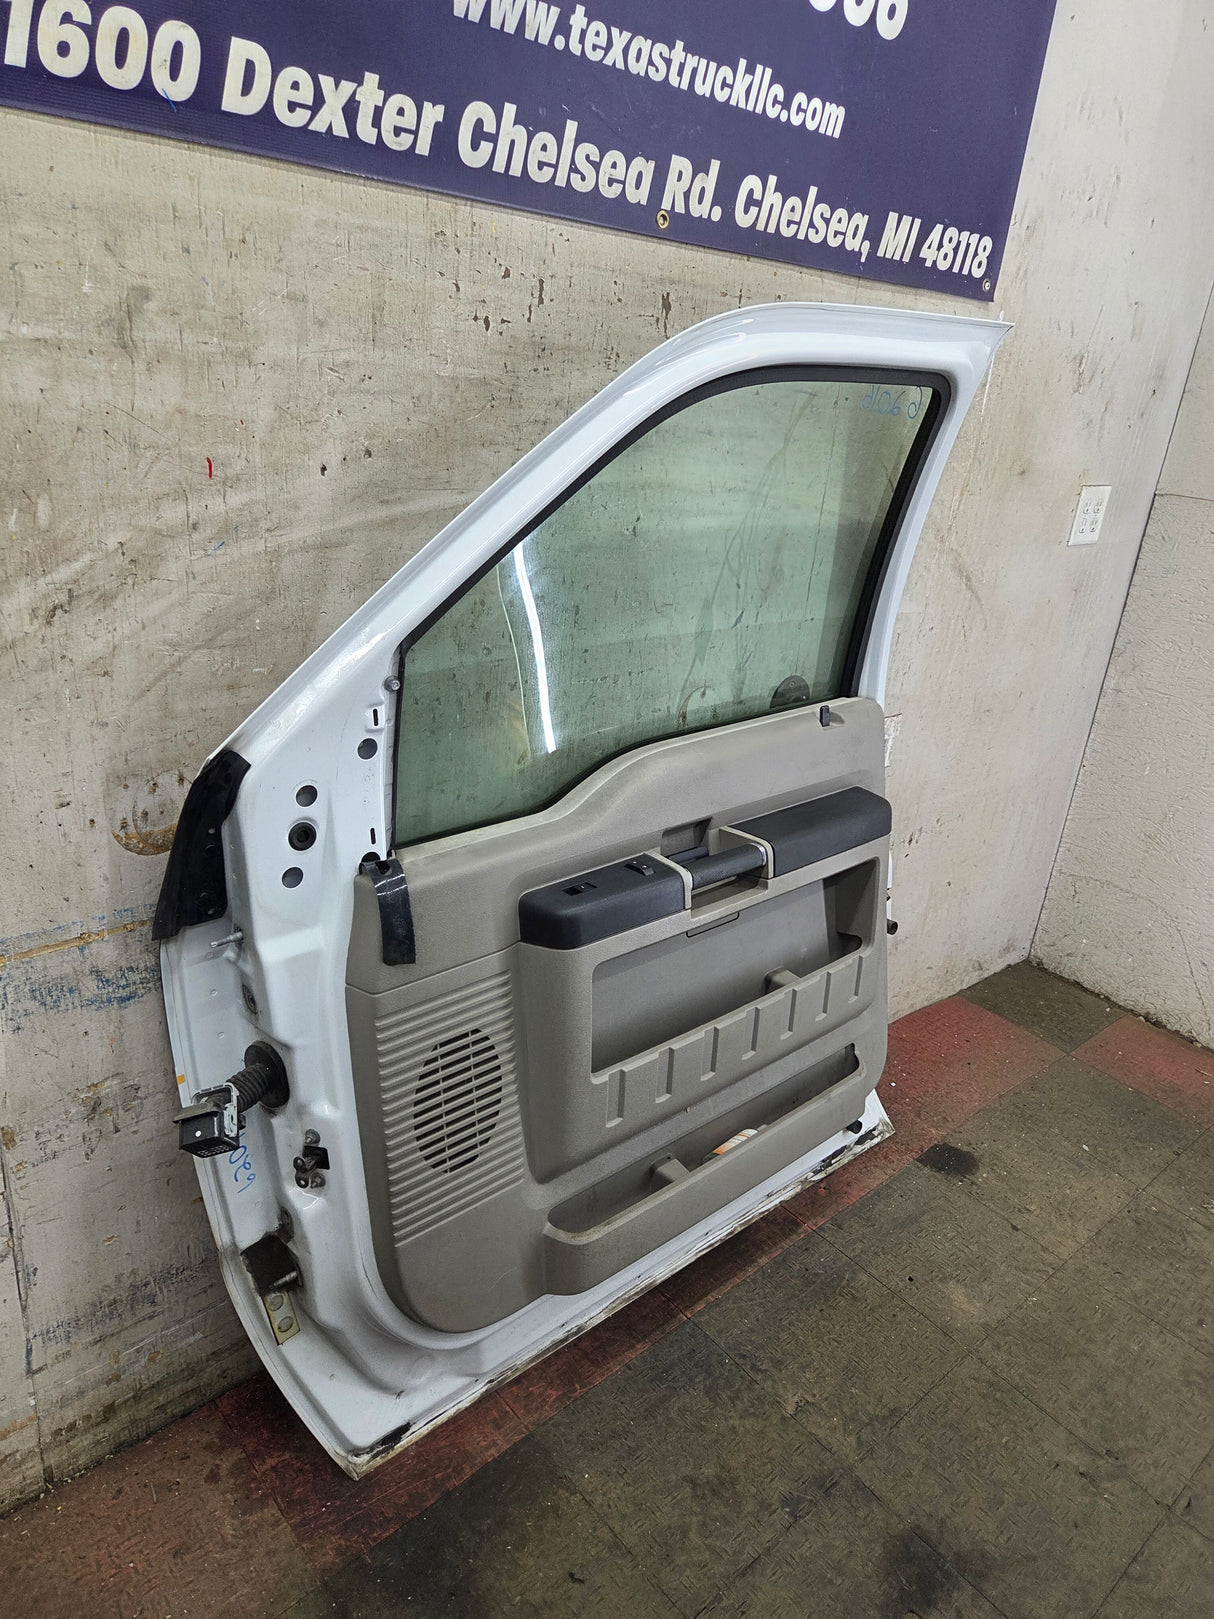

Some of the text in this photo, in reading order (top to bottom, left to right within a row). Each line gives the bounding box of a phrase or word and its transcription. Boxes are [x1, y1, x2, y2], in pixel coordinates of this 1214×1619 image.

[2, 0, 993, 279] 1600 Dexter Chelsea Rd. Chelsea, MI 48118
